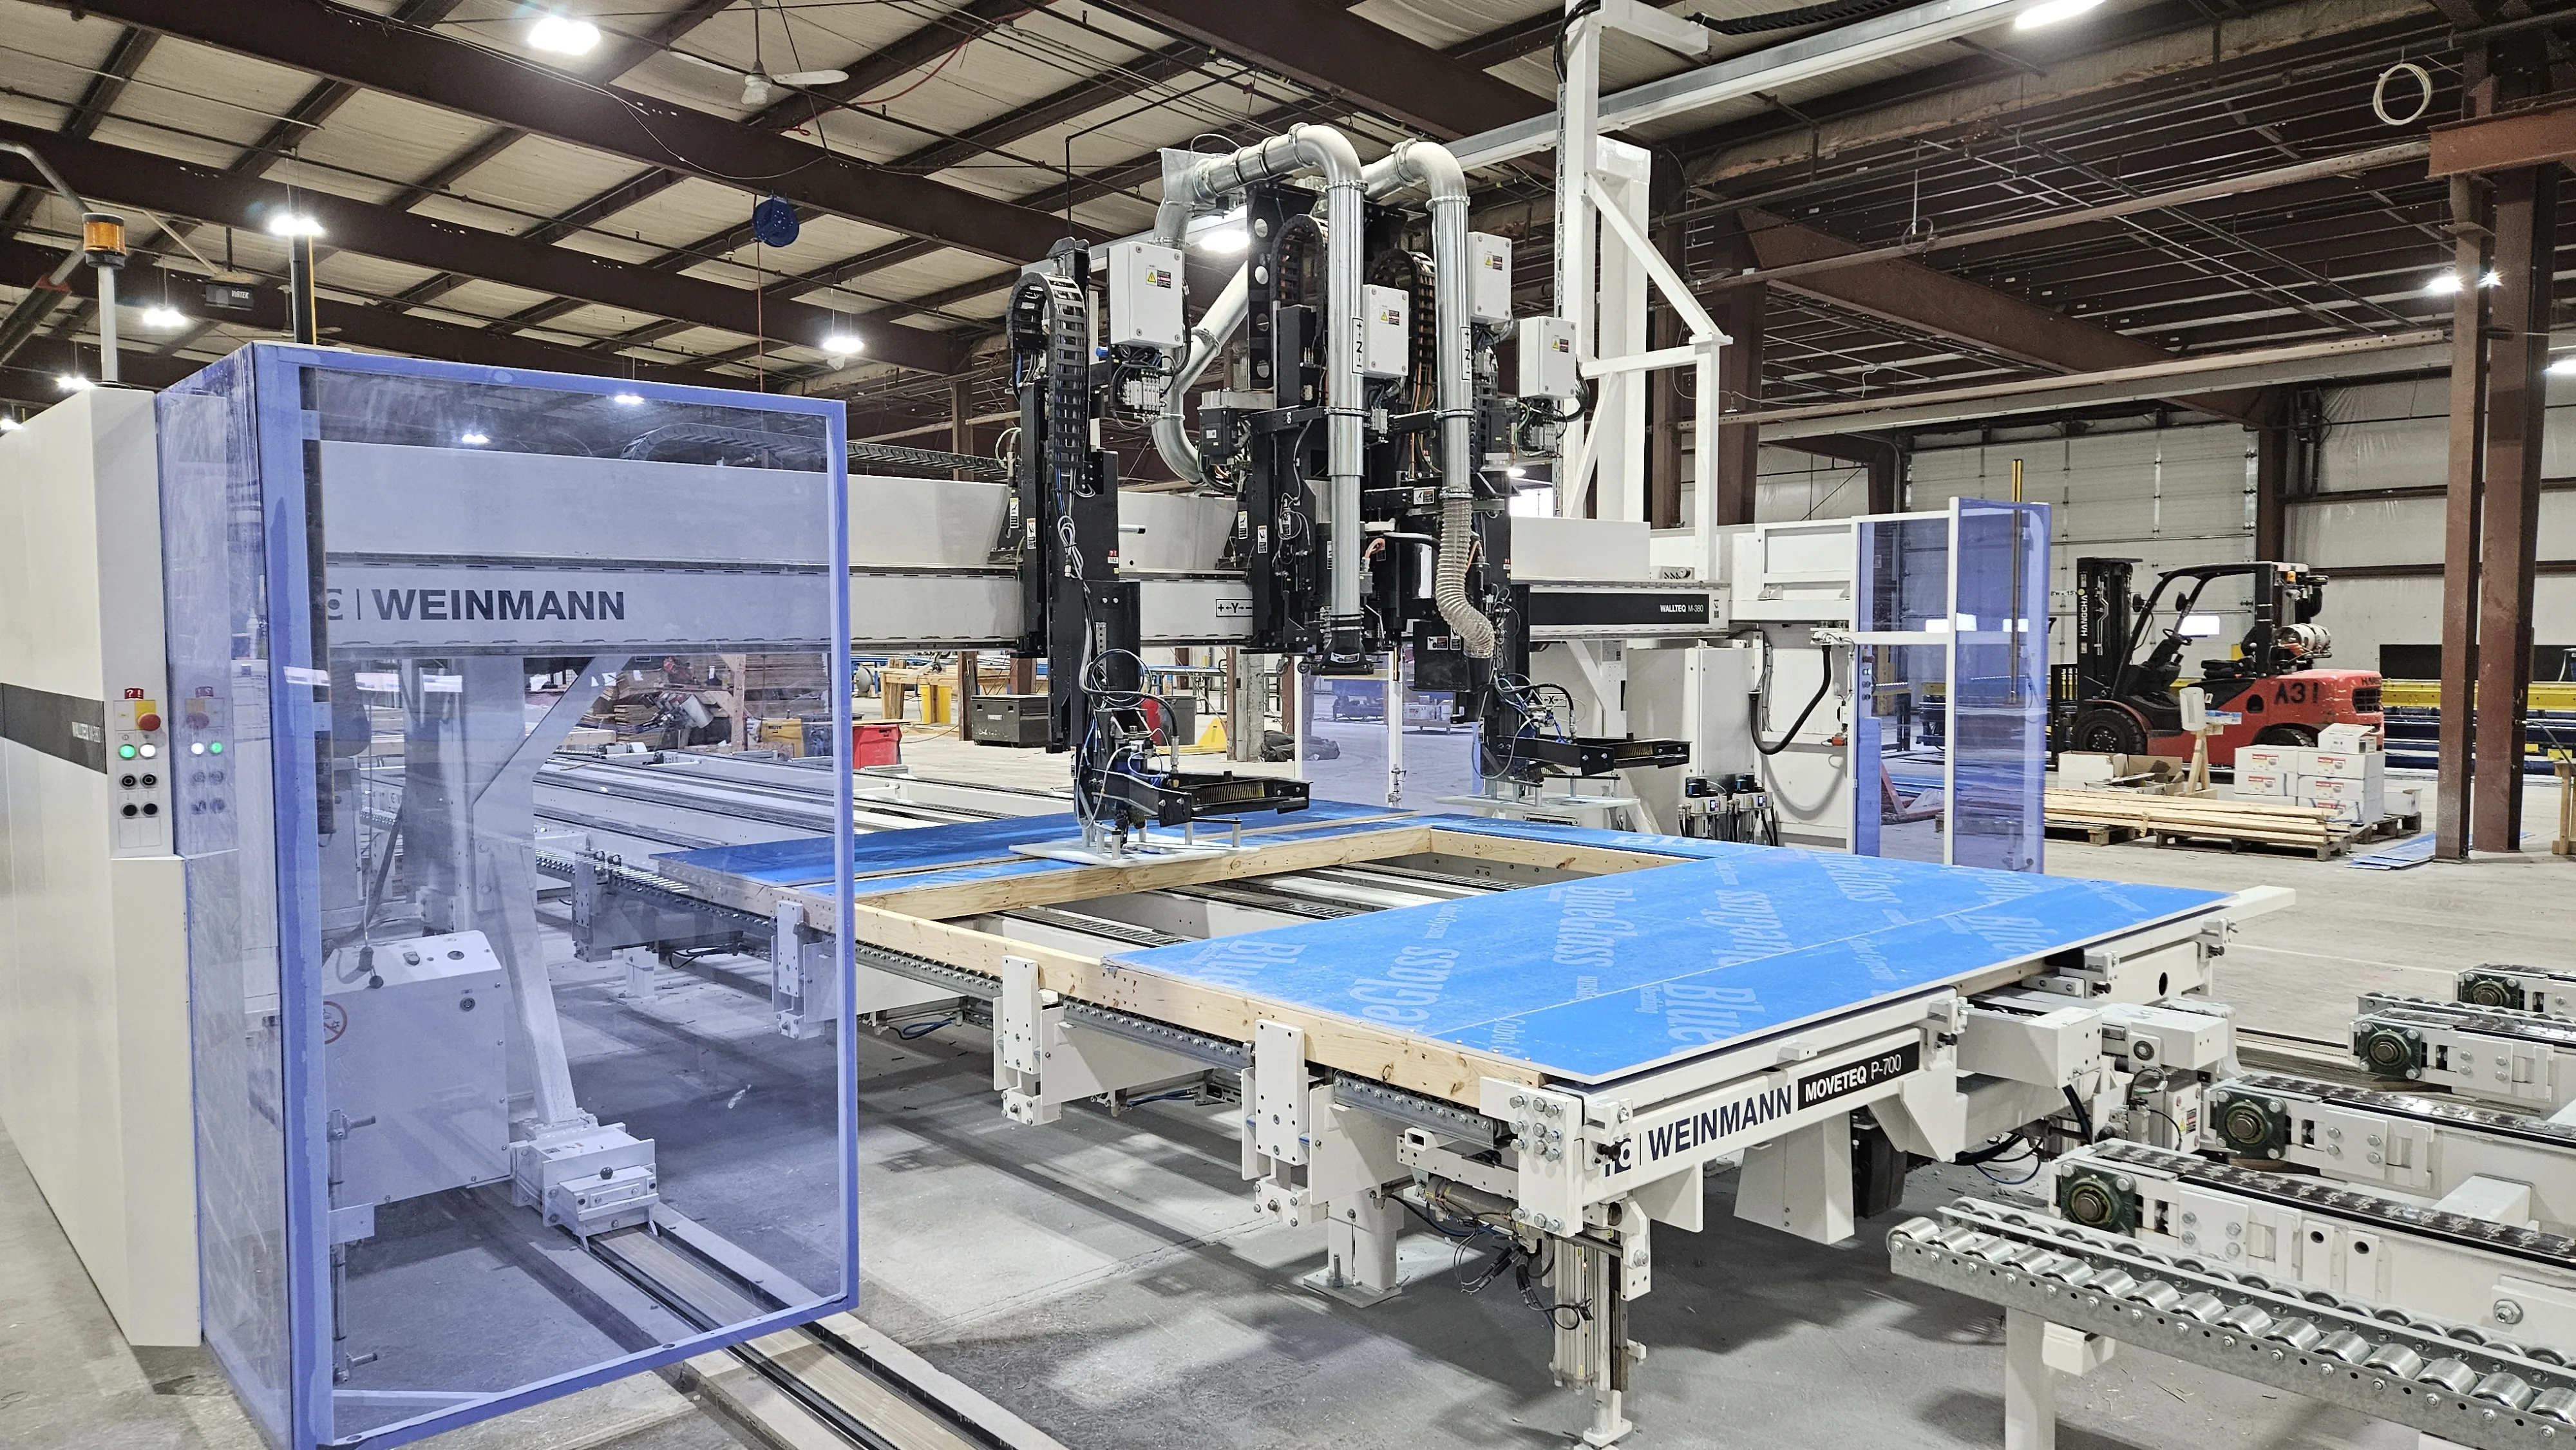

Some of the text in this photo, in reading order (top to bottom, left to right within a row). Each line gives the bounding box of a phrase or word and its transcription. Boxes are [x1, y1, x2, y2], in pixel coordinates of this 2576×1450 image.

[371, 588, 625, 621] WEINMANN
[1660, 604, 1704, 613] WALLTEQ M-380
[2080, 594, 2088, 637] HANGCHA
[2274, 681, 2319, 705] A31
[1553, 885, 1639, 967] BlueGlass
[1960, 914, 2060, 959] Blue
[1349, 946, 1461, 1033] eGlass
[1490, 1019, 1526, 1044] Cabot
[1663, 981, 1789, 1055] Blue
[1804, 1053, 1902, 1102] MOVETEQ P-700
[1647, 1084, 1792, 1161] WEINMANN
